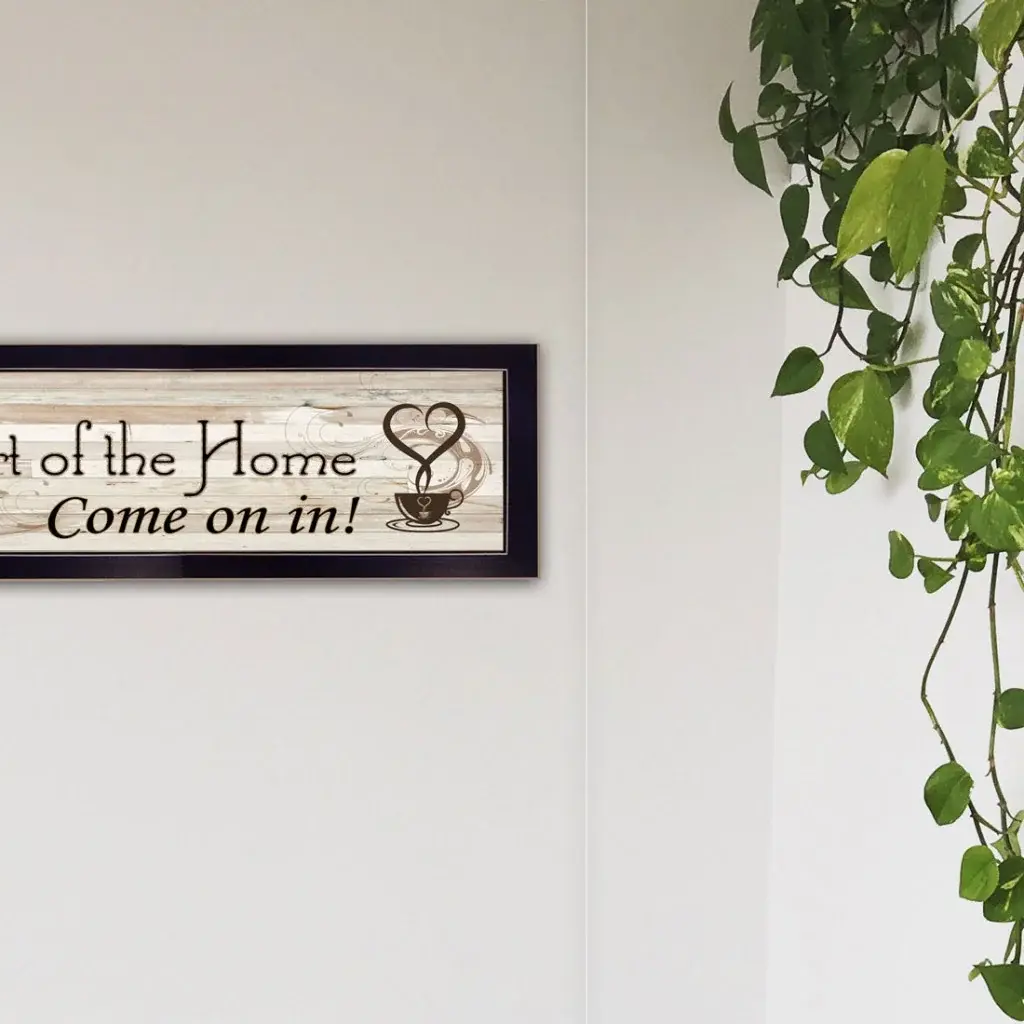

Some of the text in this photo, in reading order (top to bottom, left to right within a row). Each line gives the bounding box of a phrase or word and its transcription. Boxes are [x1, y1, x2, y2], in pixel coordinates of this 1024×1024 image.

[41, 419, 93, 476] of
[104, 420, 176, 476] the
[182, 418, 357, 498] Home
[47, 494, 360, 539] Come on in!
